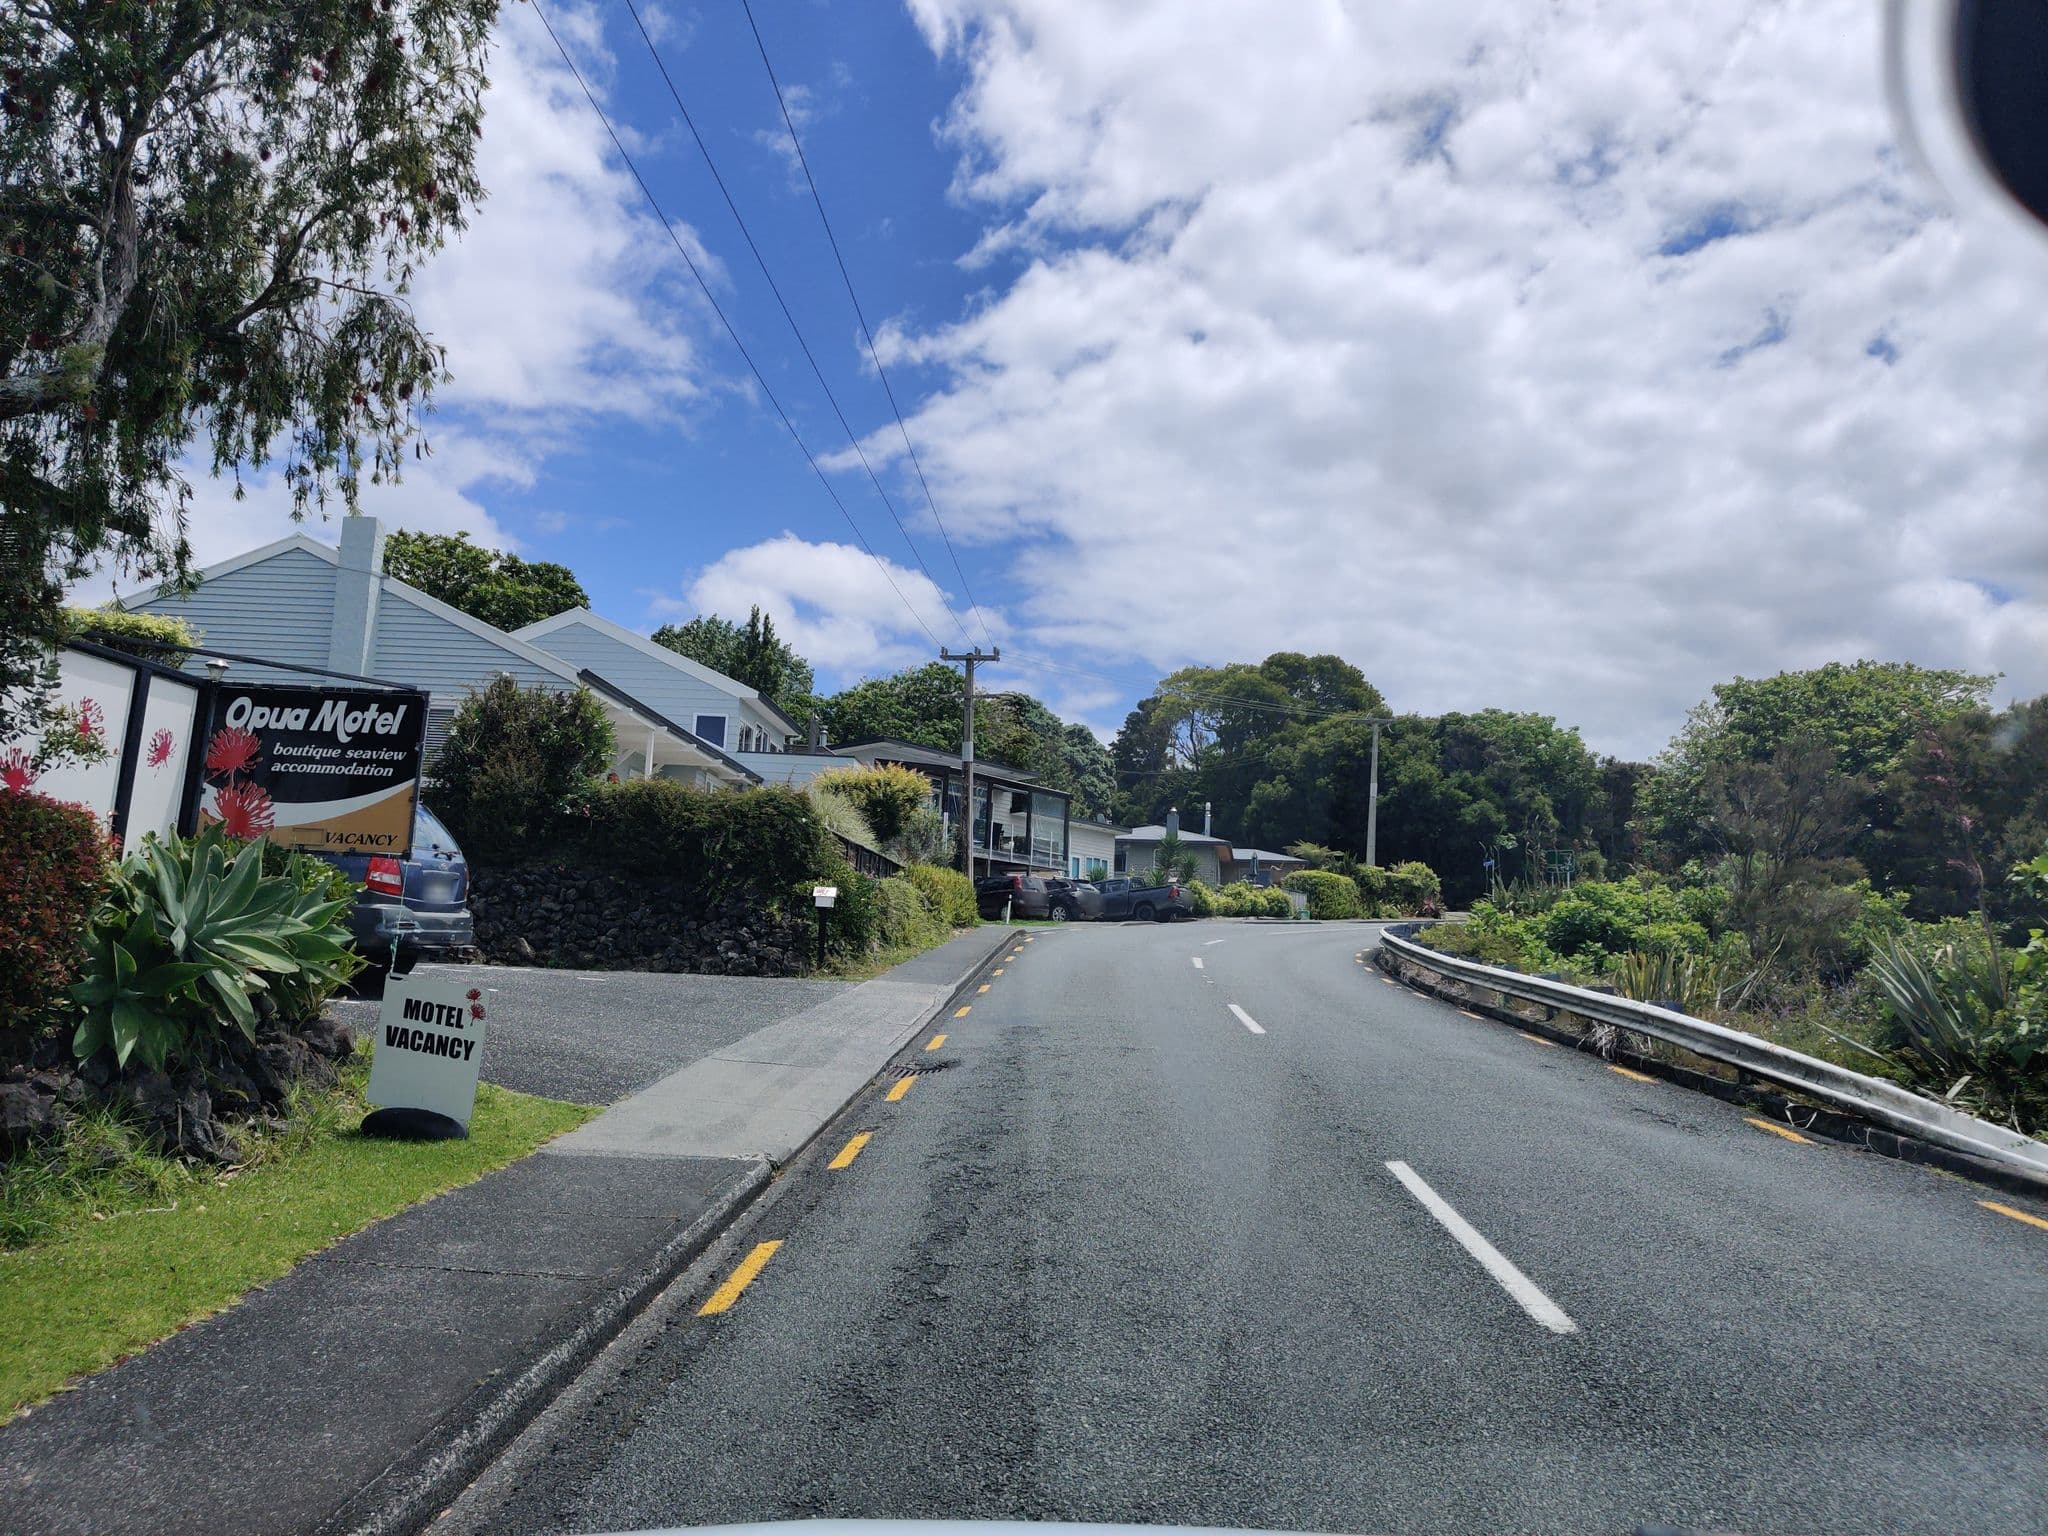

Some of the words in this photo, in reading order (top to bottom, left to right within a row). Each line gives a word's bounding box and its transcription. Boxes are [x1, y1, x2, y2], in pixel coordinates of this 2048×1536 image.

[225, 696, 310, 736] Opua
[309, 699, 408, 743] Motel
[272, 742, 341, 760] boutique
[345, 747, 407, 762] seaview
[270, 760, 394, 777] accommodation
[325, 831, 398, 846] VACANCY
[403, 998, 464, 1029] MOTEL
[385, 1025, 475, 1061] VACANCY
